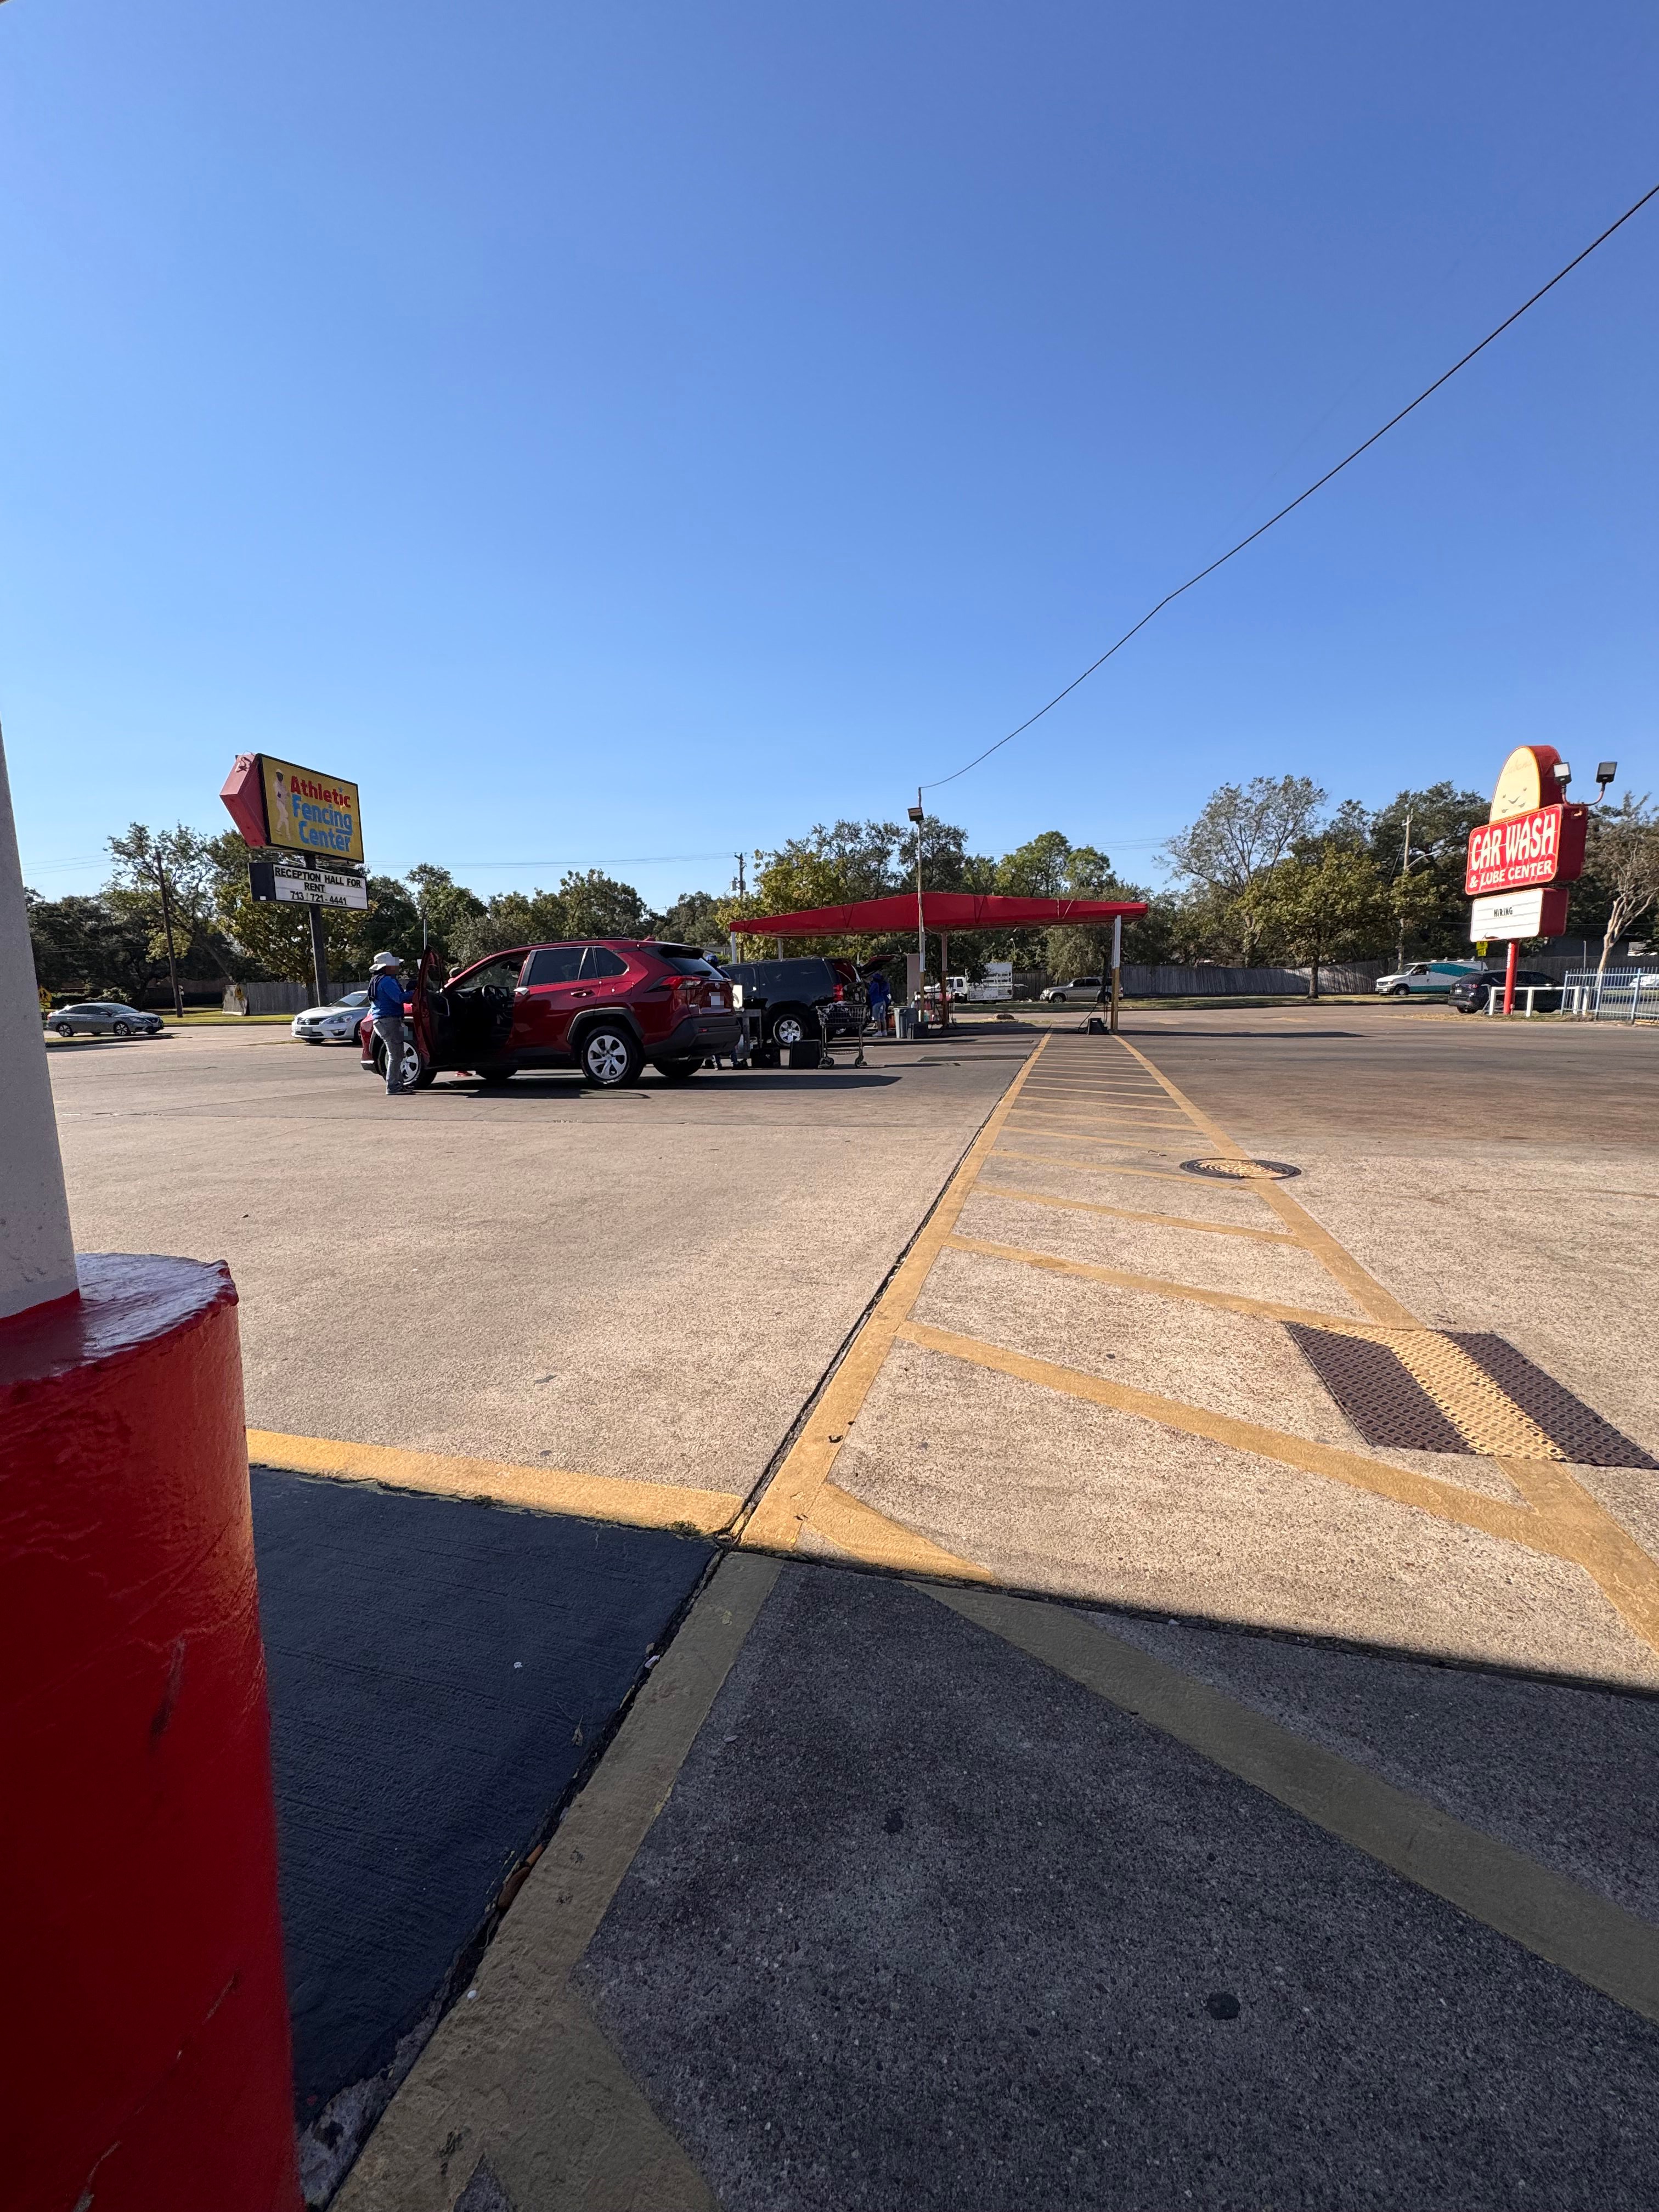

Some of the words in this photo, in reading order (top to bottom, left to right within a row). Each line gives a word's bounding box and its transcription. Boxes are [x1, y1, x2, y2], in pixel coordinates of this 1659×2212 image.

[291, 776, 351, 808] Athletic
[292, 794, 353, 836] Fencing
[298, 821, 351, 852] Center
[1471, 829, 1502, 871] CAR
[1506, 814, 1555, 864] WASH
[275, 867, 321, 882] RECEPTION
[324, 874, 344, 885] HALL
[347, 878, 362, 888] FOR
[304, 883, 326, 893] RENT
[1469, 875, 1479, 888] &
[1481, 870, 1505, 886] LUBE
[1508, 860, 1552, 880] CENTER
[291, 891, 304, 900] 713
[1494, 907, 1513, 918] HIRING
